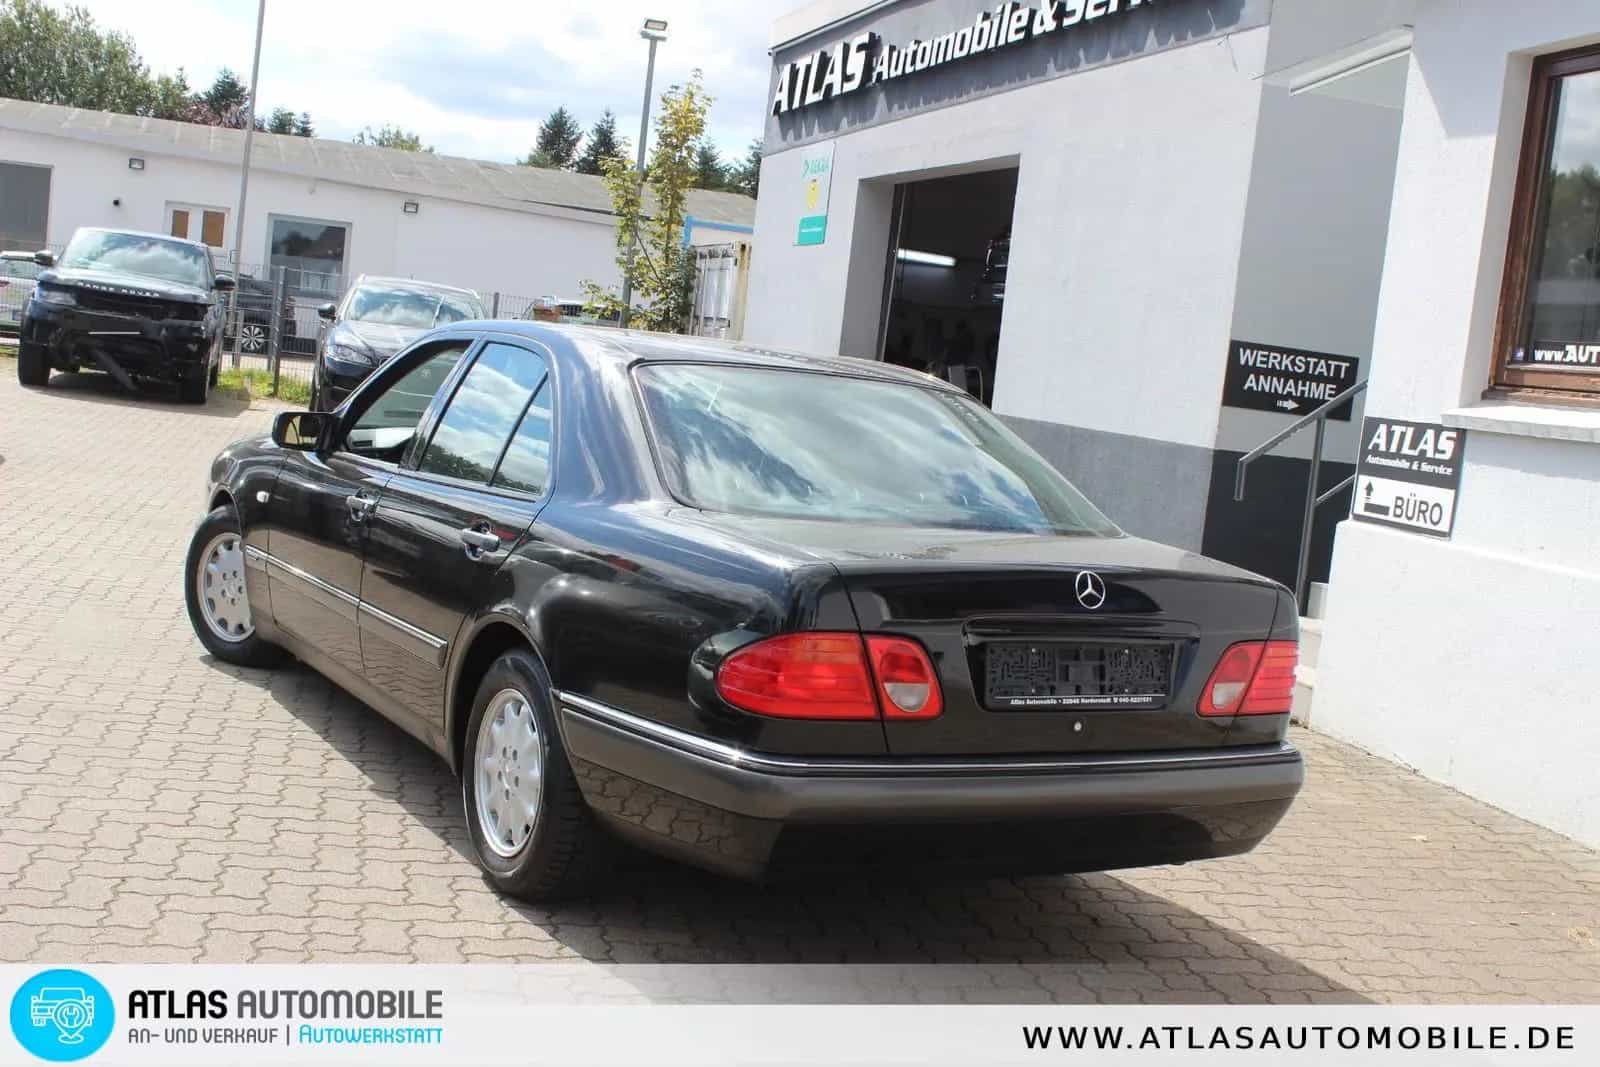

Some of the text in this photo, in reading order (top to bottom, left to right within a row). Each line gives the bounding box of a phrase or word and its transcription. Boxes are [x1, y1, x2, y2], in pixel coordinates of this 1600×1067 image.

[771, 32, 870, 116] ATLAS
[872, 3, 1027, 83] Automobile
[1239, 347, 1350, 379] WERKSTATT
[1243, 374, 1337, 401] ANNAHME
[1368, 424, 1457, 460] ATLAS
[1420, 462, 1453, 475] Service
[1392, 492, 1443, 526] BÜRO
